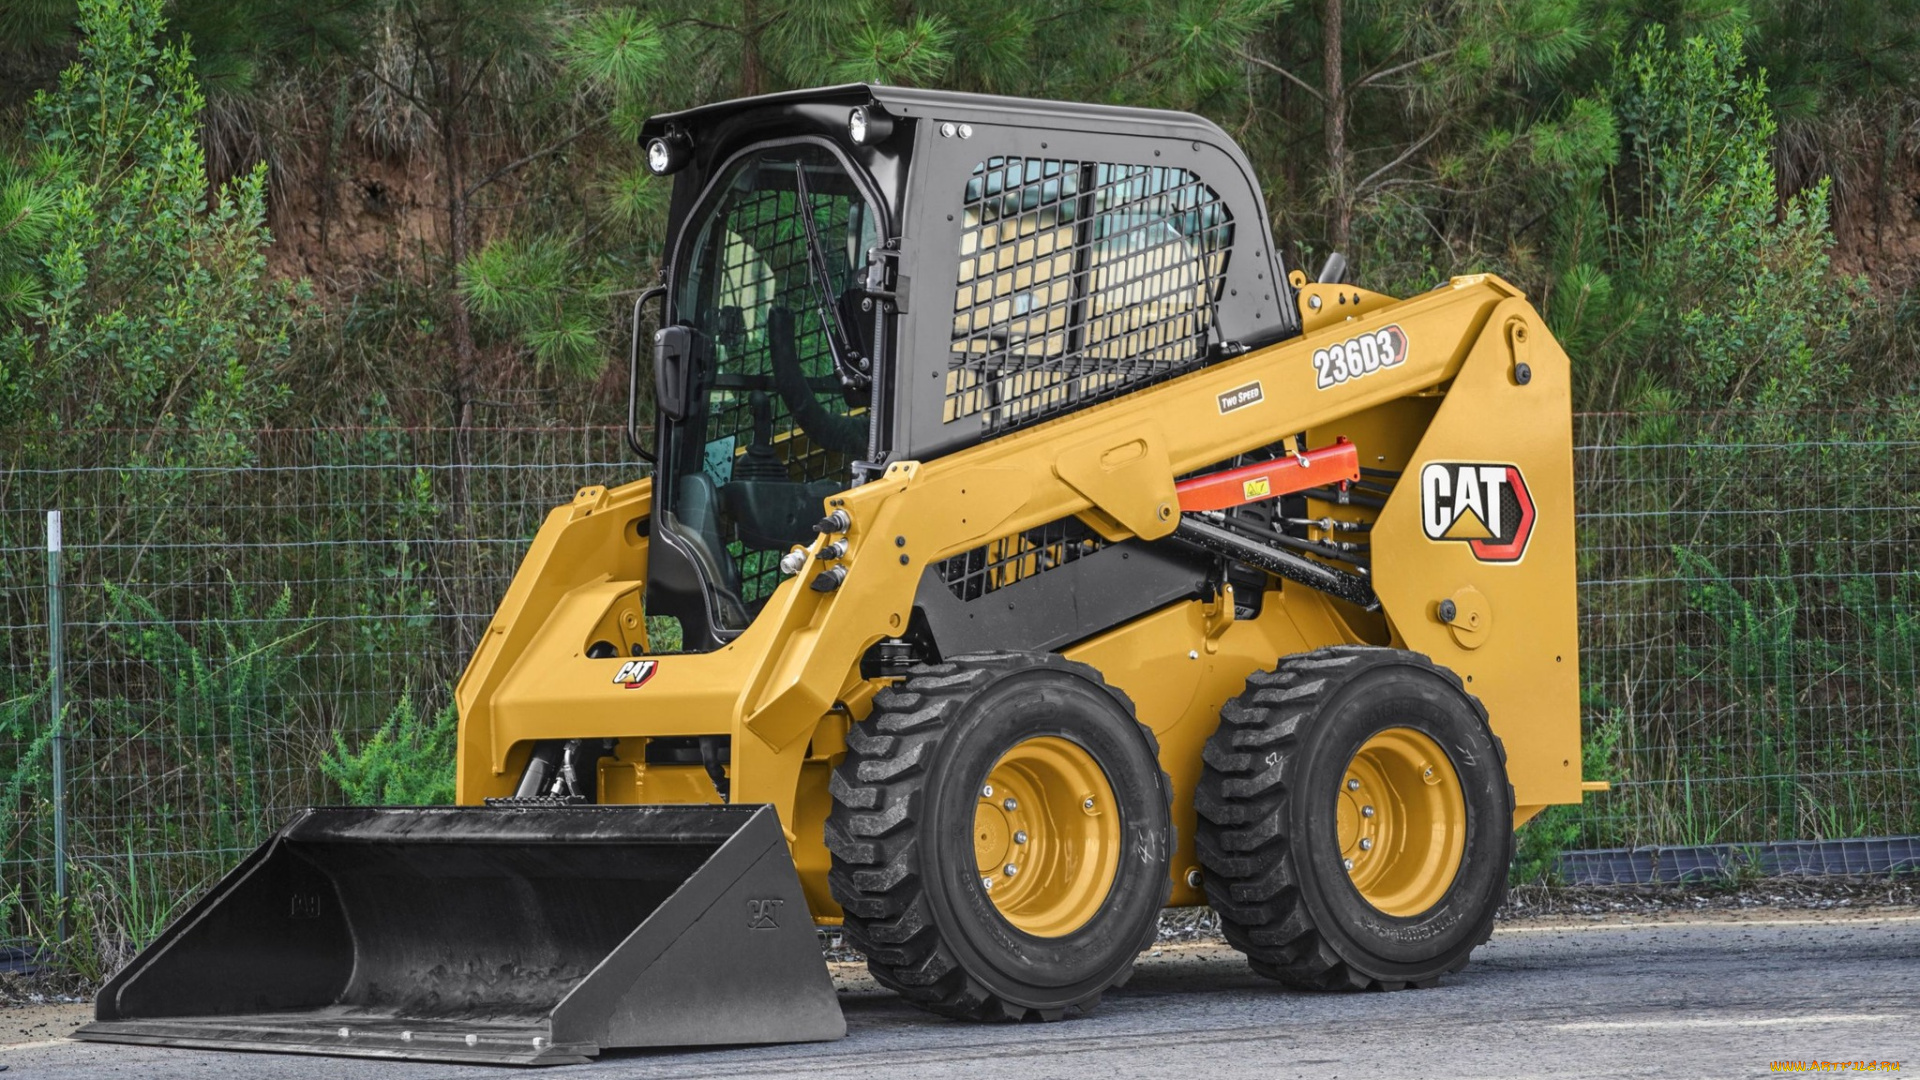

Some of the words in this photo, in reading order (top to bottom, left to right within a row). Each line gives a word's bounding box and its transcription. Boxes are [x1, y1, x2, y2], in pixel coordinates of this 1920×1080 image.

[1314, 330, 1395, 387] 236D3
[1422, 464, 1507, 539] CAT
[613, 660, 655, 683] CAT
[746, 899, 784, 930] CAT
